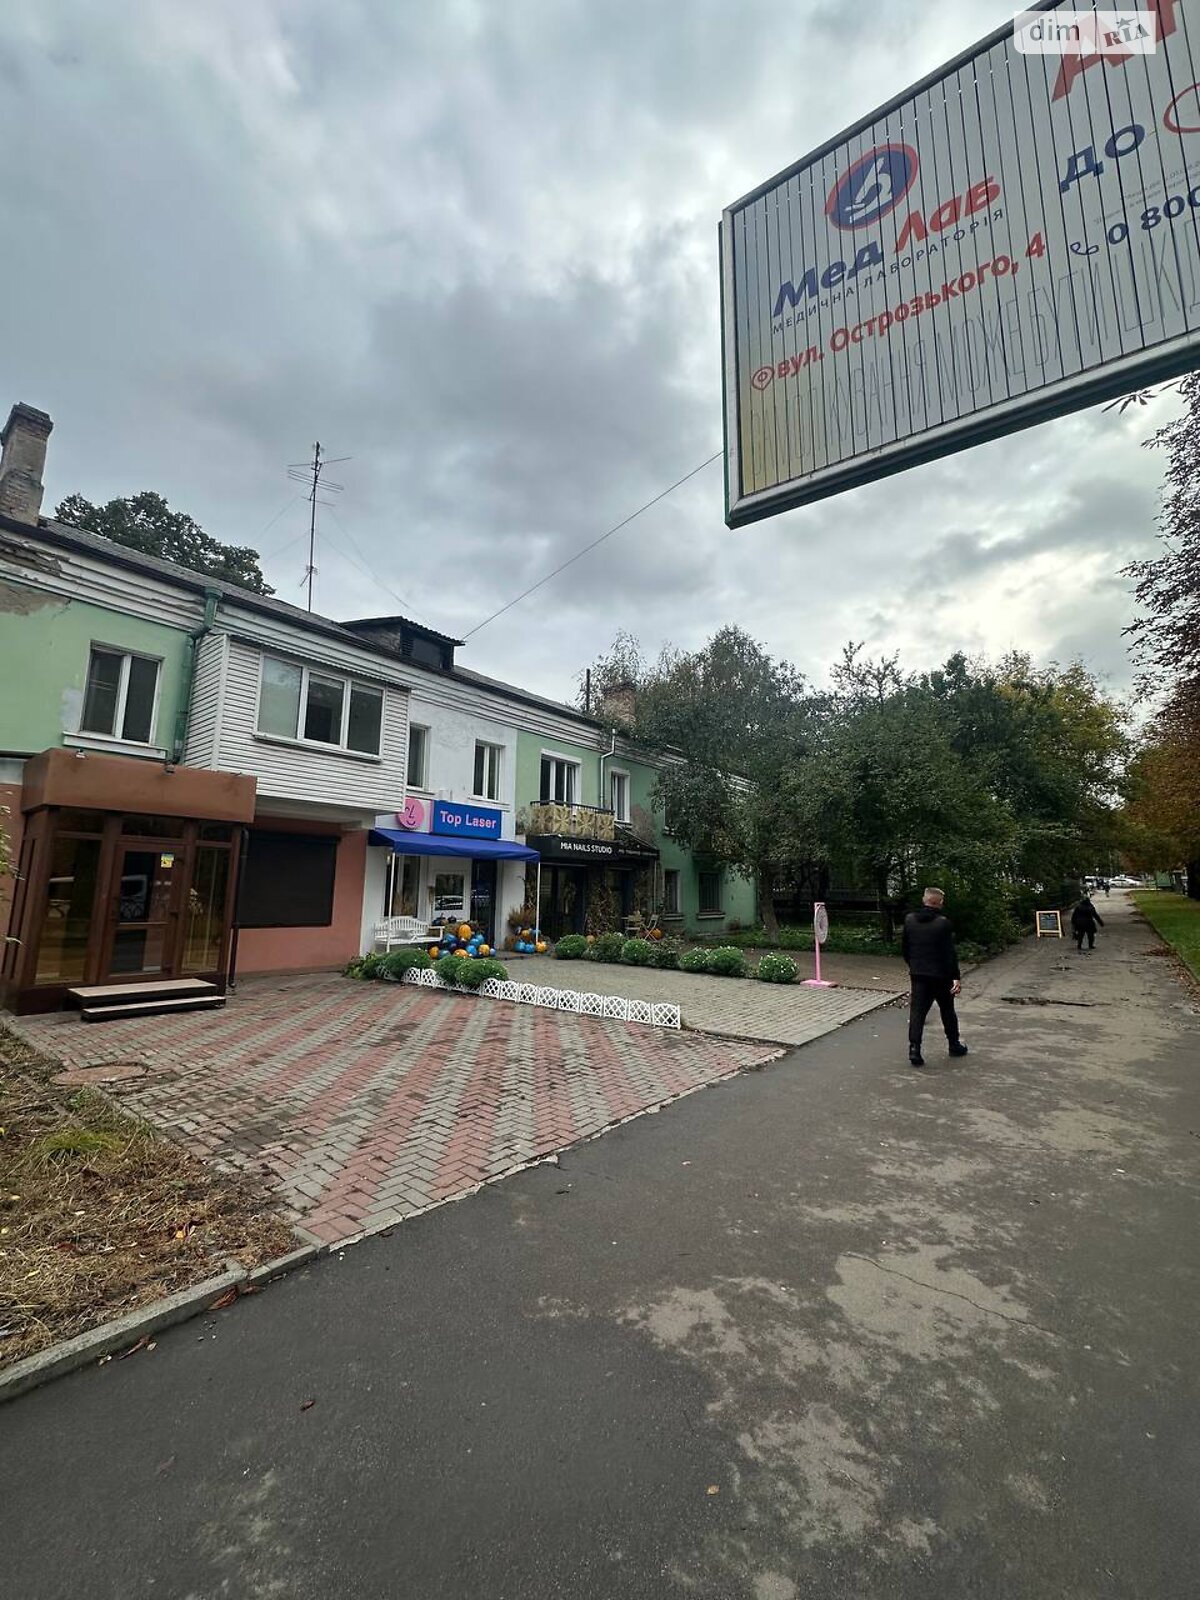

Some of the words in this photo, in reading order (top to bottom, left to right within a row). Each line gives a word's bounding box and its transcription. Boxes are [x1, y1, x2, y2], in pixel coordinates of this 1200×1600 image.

[773, 286, 855, 335] МЕДИЧНА
[864, 208, 1004, 289] ЛАБОРАТОРІЯ
[1108, 223, 1129, 245] 0
[773, 241, 884, 318] Мед
[777, 345, 825, 378] вул.
[830, 254, 1019, 352] Острозького,
[1025, 231, 1046, 258] 4
[936, 299, 1025, 403] МОЖЕ
[1028, 262, 1108, 367] БУТИ
[440, 810, 462, 828] Top
[465, 814, 497, 829] Laser
[560, 842, 572, 850] MIA
[573, 843, 590, 852] NAILS
[591, 844, 613, 854] STUDIO
